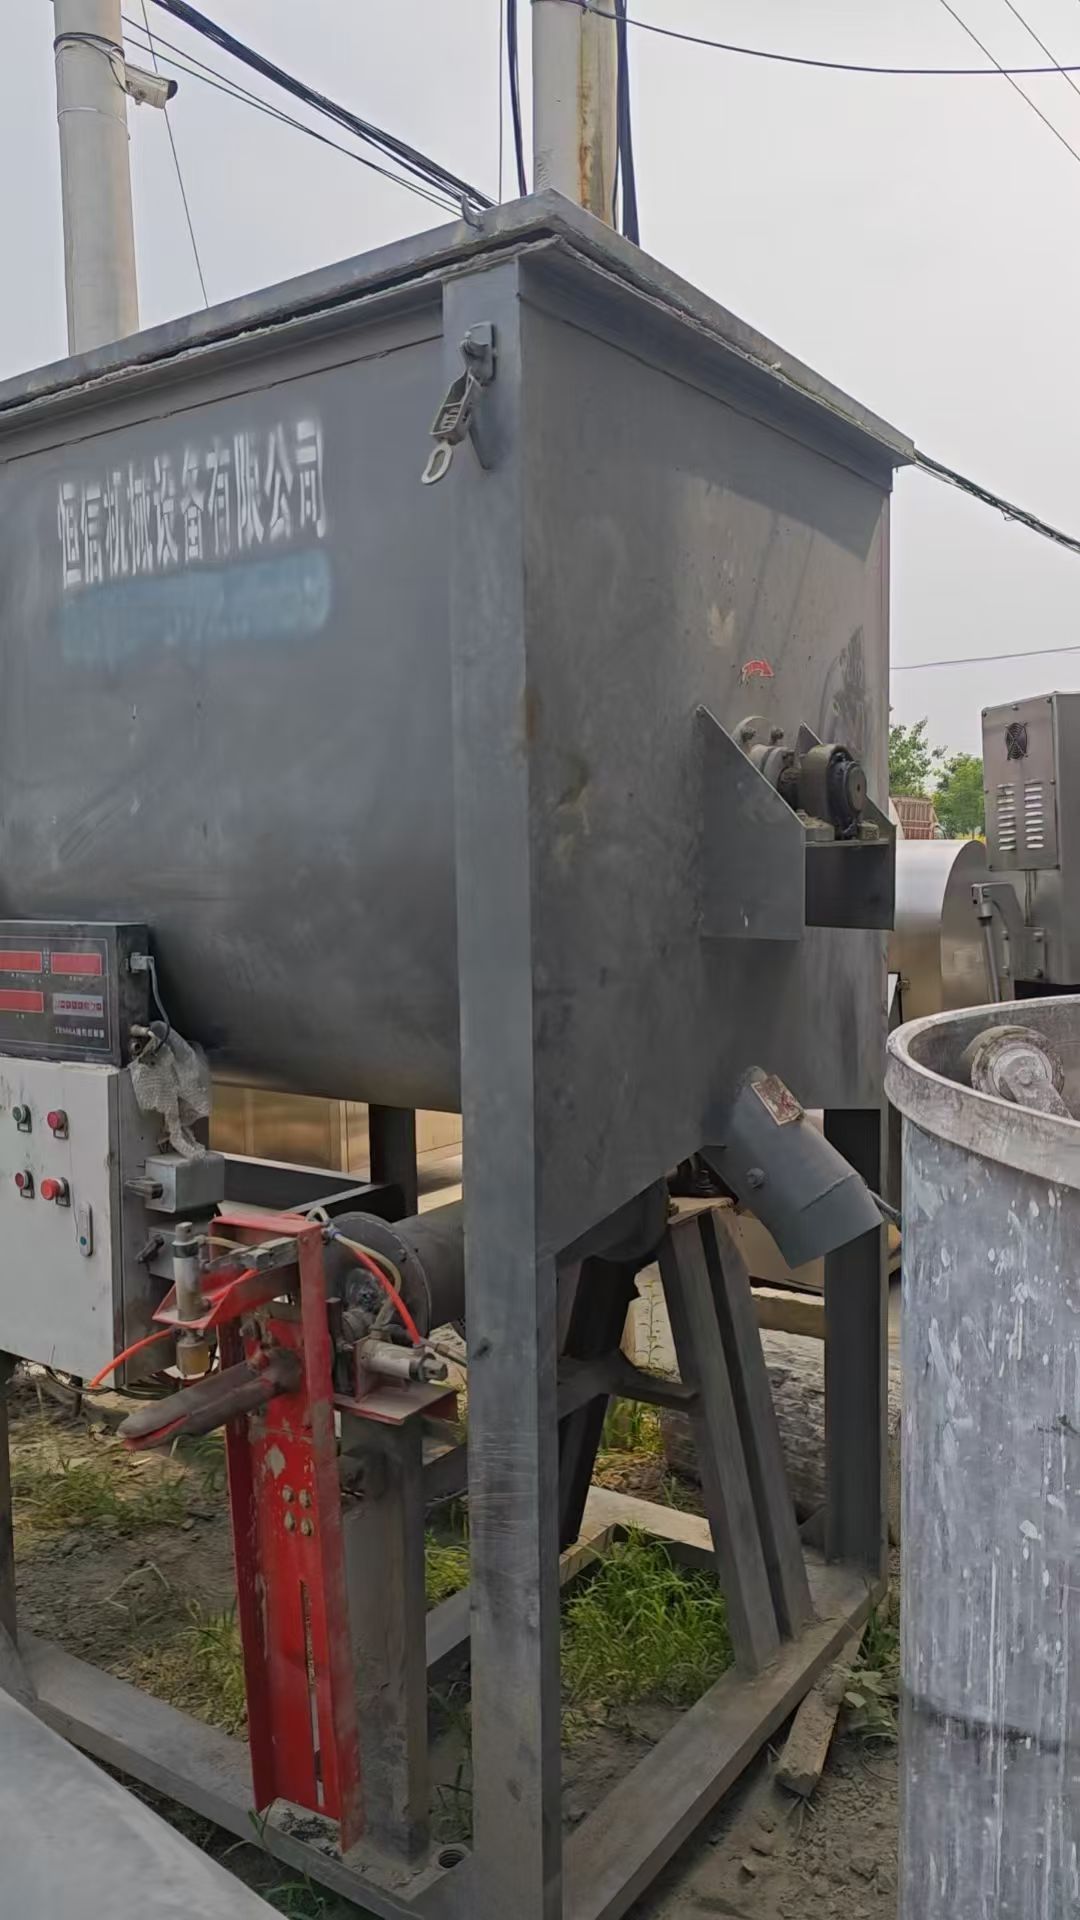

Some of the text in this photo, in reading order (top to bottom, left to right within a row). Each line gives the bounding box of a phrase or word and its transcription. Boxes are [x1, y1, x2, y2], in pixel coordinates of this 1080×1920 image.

[57, 418, 328, 590] 恒信机械设备有限公司
